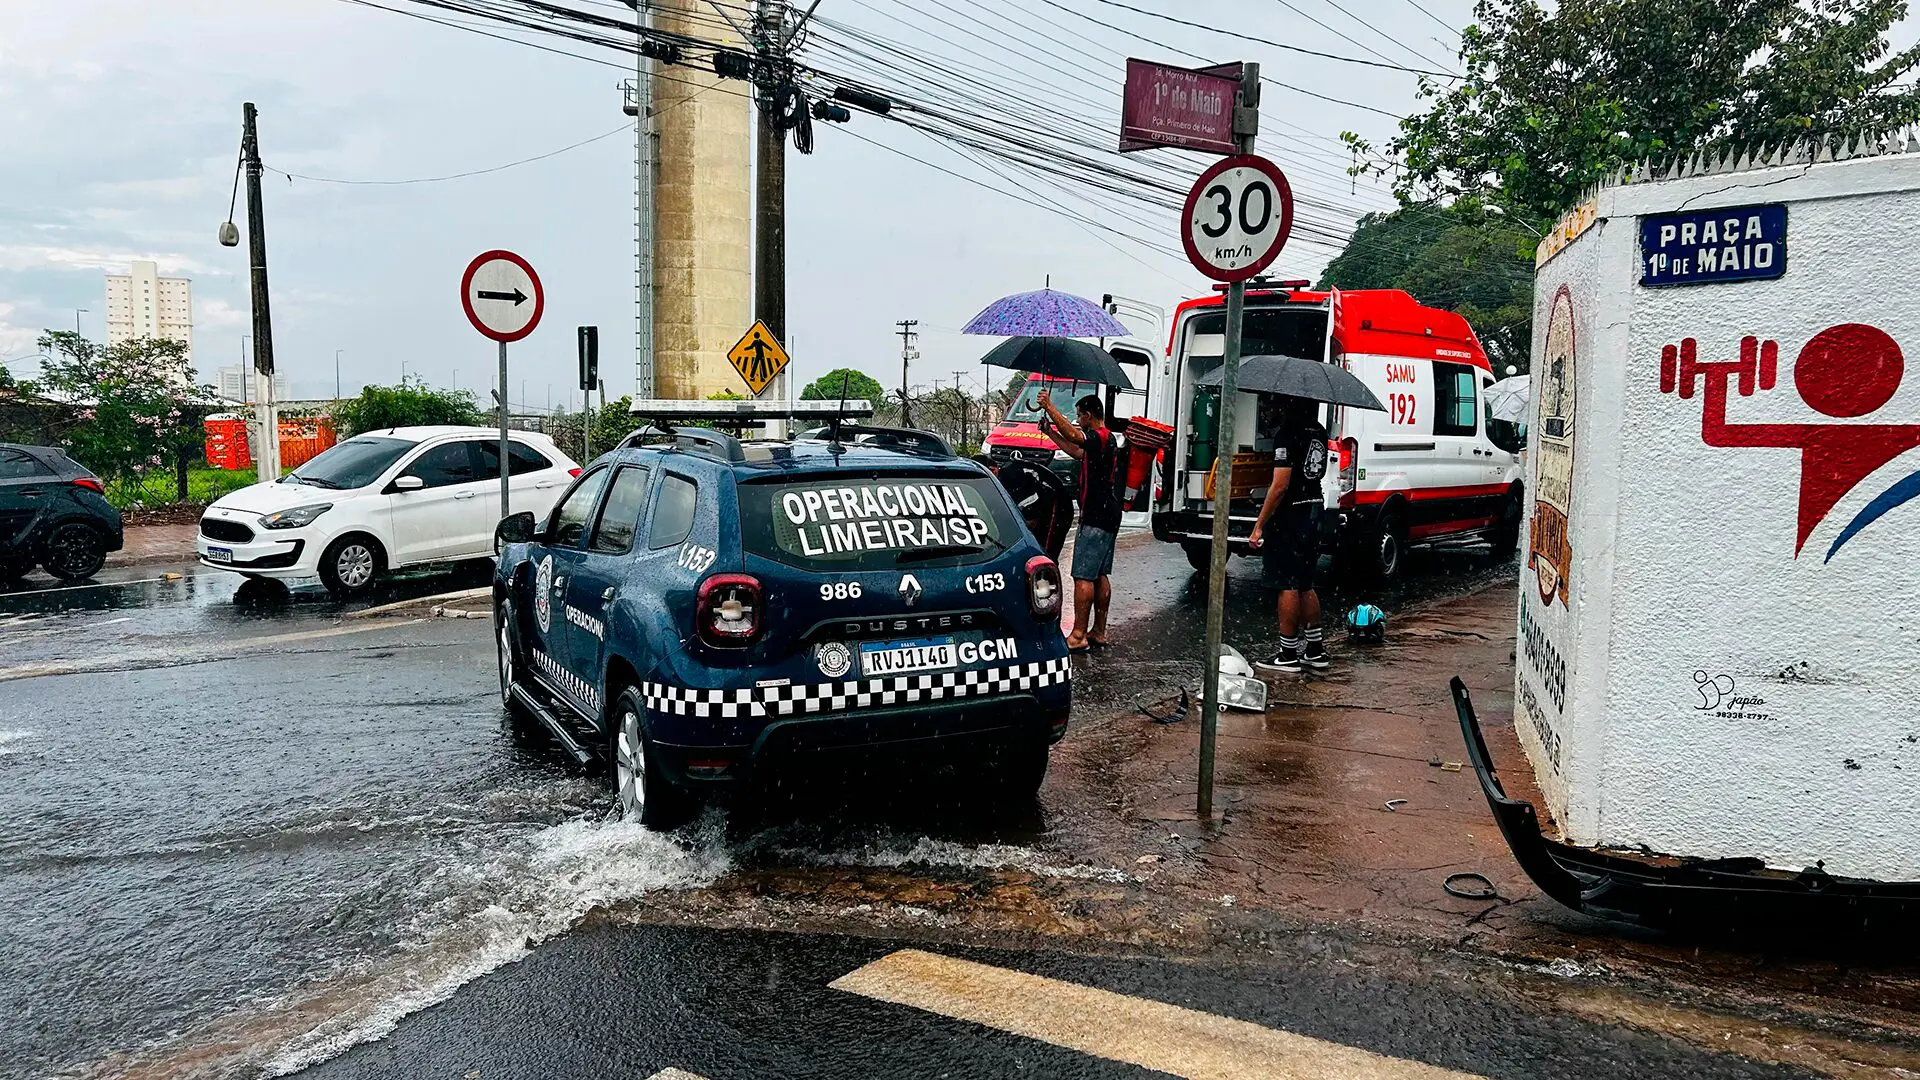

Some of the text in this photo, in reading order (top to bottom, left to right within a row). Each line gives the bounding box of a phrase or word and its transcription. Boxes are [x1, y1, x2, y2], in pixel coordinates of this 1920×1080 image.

[1172, 85, 1187, 110] de
[1191, 88, 1221, 116] Maio
[1167, 119, 1191, 130] Primeiro
[1202, 125, 1216, 134] Maio
[1201, 181, 1272, 238] 30
[1660, 216, 1763, 248] PRAÇA
[1215, 244, 1252, 259] km/h
[1649, 253, 1667, 277] 1º
[1673, 258, 1689, 275] DE
[1697, 243, 1773, 273] MAIO
[1386, 363, 1416, 384] SAMU
[1390, 393, 1416, 425] 192
[782, 485, 977, 526] OPERACIONAL
[798, 517, 990, 557] LIMEIRA/SP
[683, 545, 716, 572] 153
[820, 581, 862, 601] 986
[975, 573, 1006, 594] 153
[846, 614, 973, 634] DUSTER
[871, 646, 949, 672] RVJ1I40
[958, 638, 1019, 664] GCM
[1726, 692, 1768, 710] japão
